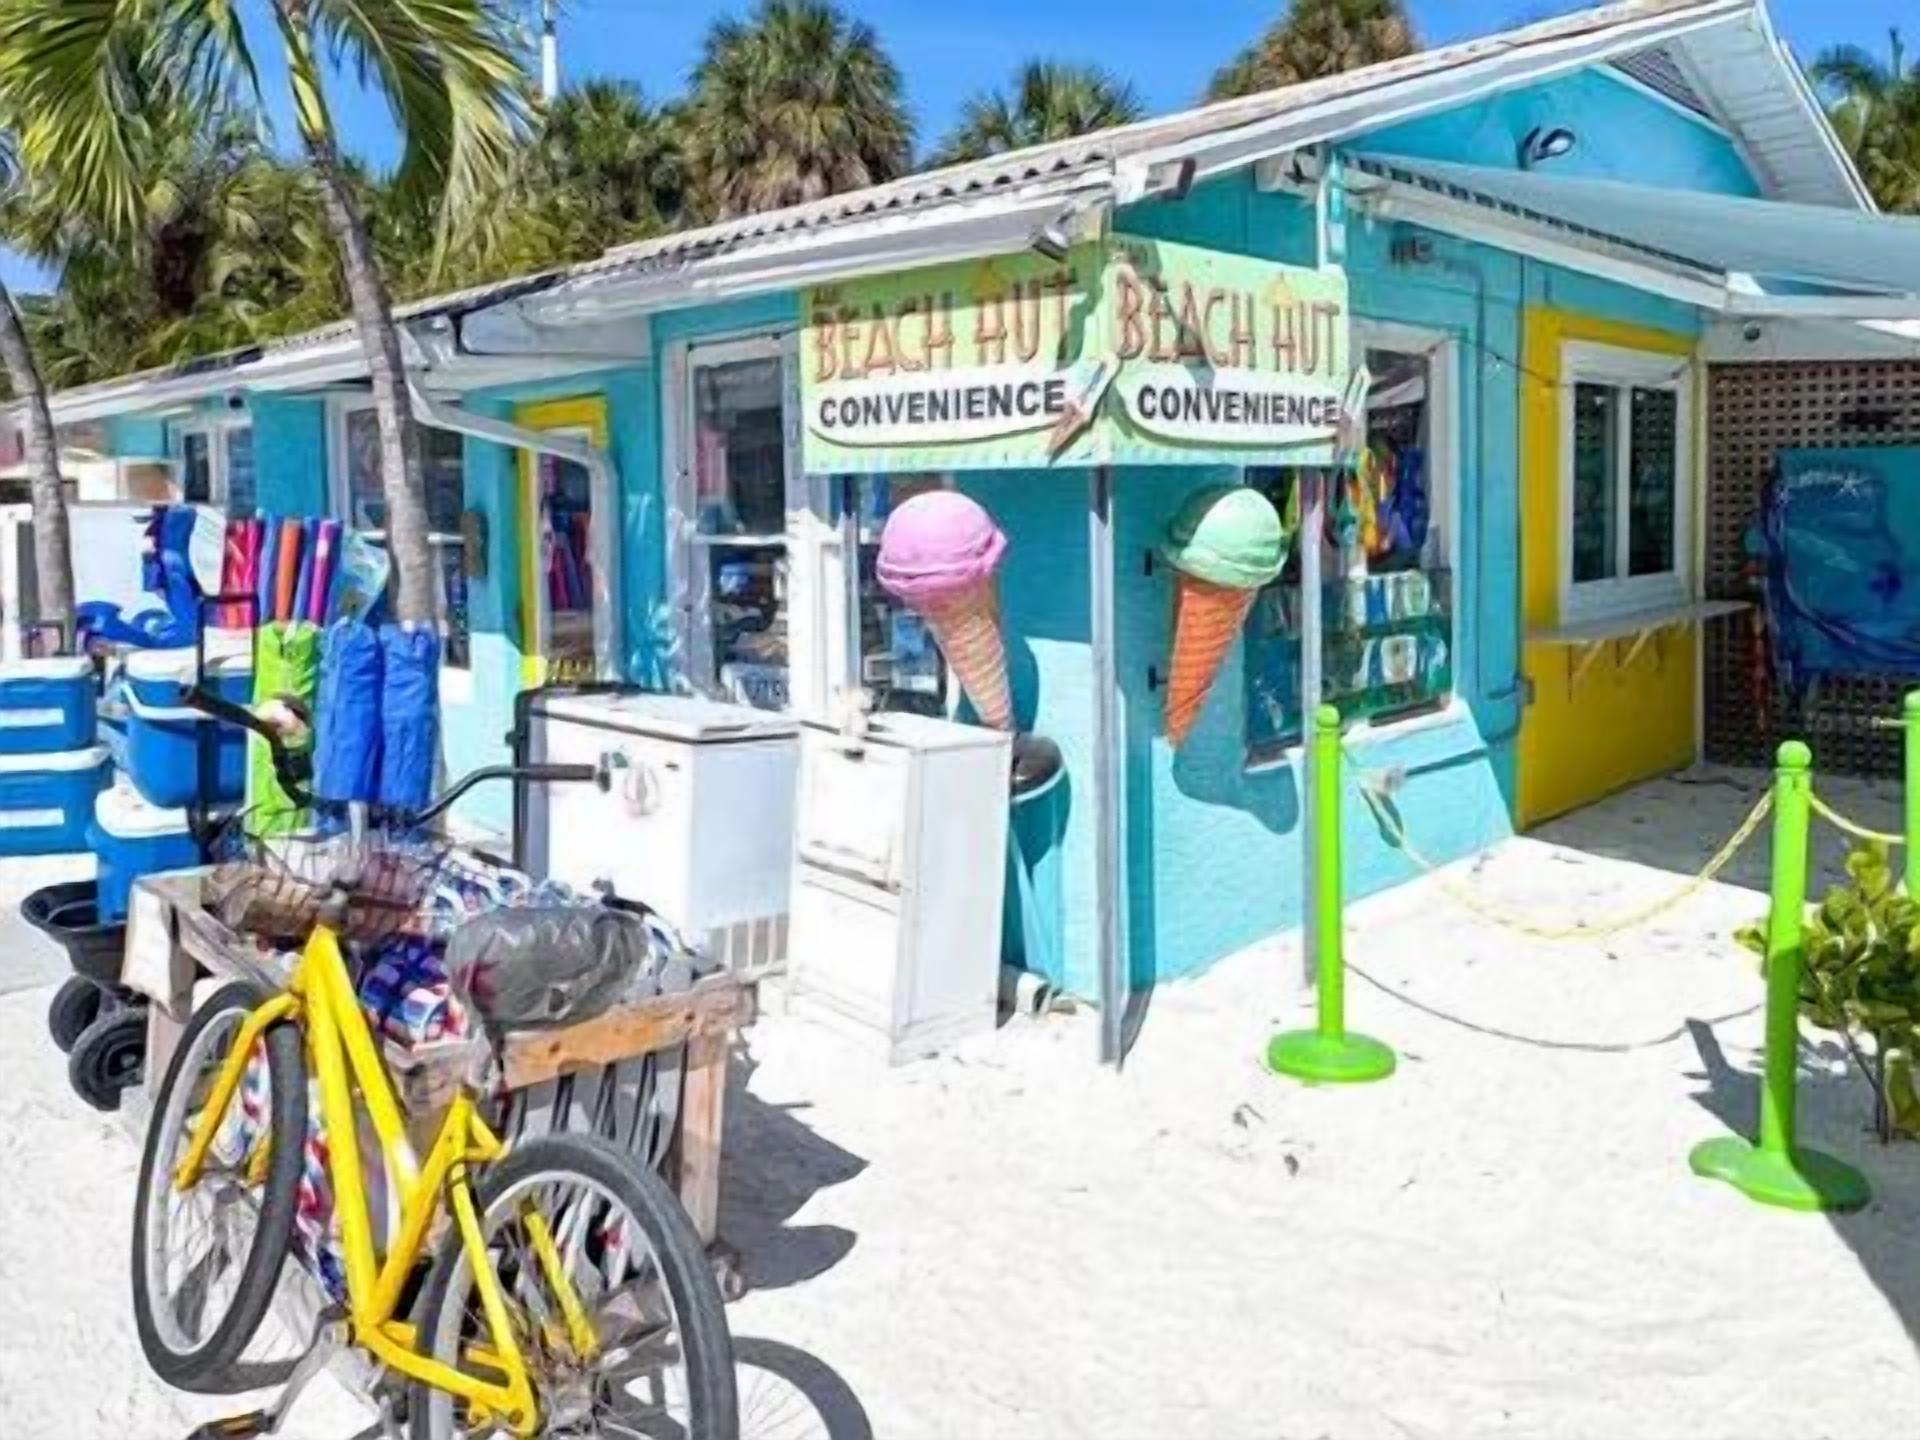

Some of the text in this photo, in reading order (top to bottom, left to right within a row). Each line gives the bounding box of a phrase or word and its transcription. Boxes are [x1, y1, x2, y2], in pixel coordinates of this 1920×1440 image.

[812, 268, 1078, 383] BEACH HUT
[1112, 268, 1340, 377] BEACH HUT
[819, 379, 1066, 428] CONVENIENCE
[1137, 383, 1337, 427] CONVENIENCE
